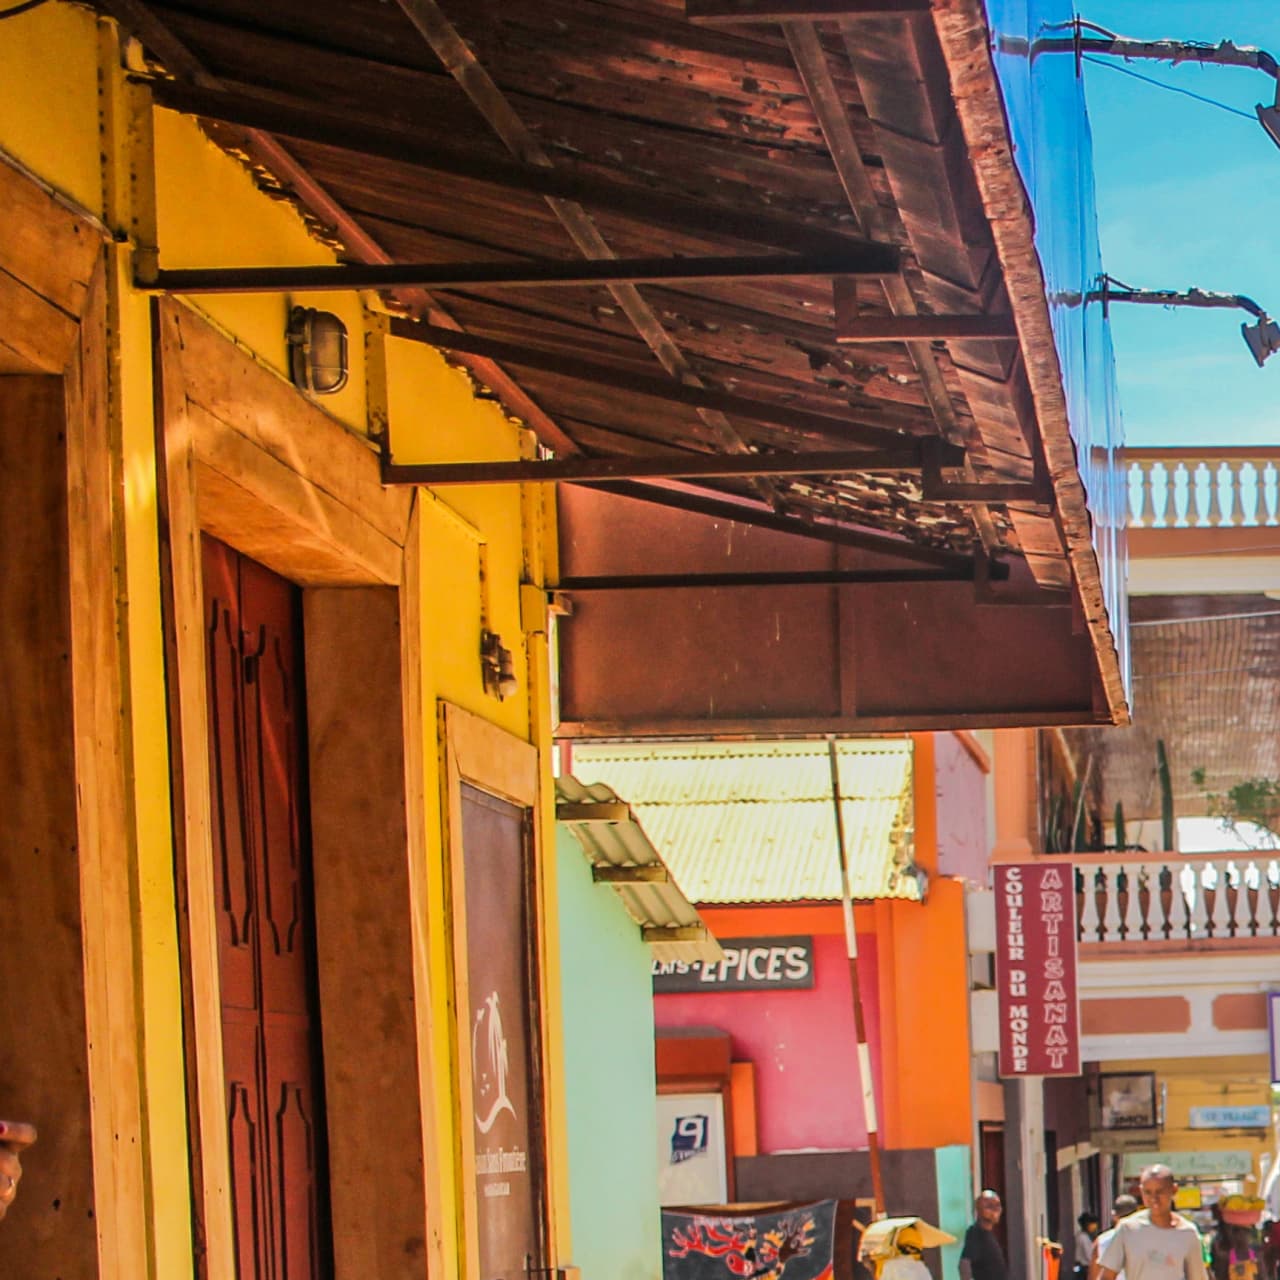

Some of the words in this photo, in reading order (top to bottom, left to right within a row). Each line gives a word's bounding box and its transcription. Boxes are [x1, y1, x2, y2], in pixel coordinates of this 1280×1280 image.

[1005, 867, 1025, 961] COULEUR
[1010, 972, 1026, 998] DU
[1039, 867, 1068, 1070] ARTISANAT
[1010, 1005, 1029, 1073] MONDE
